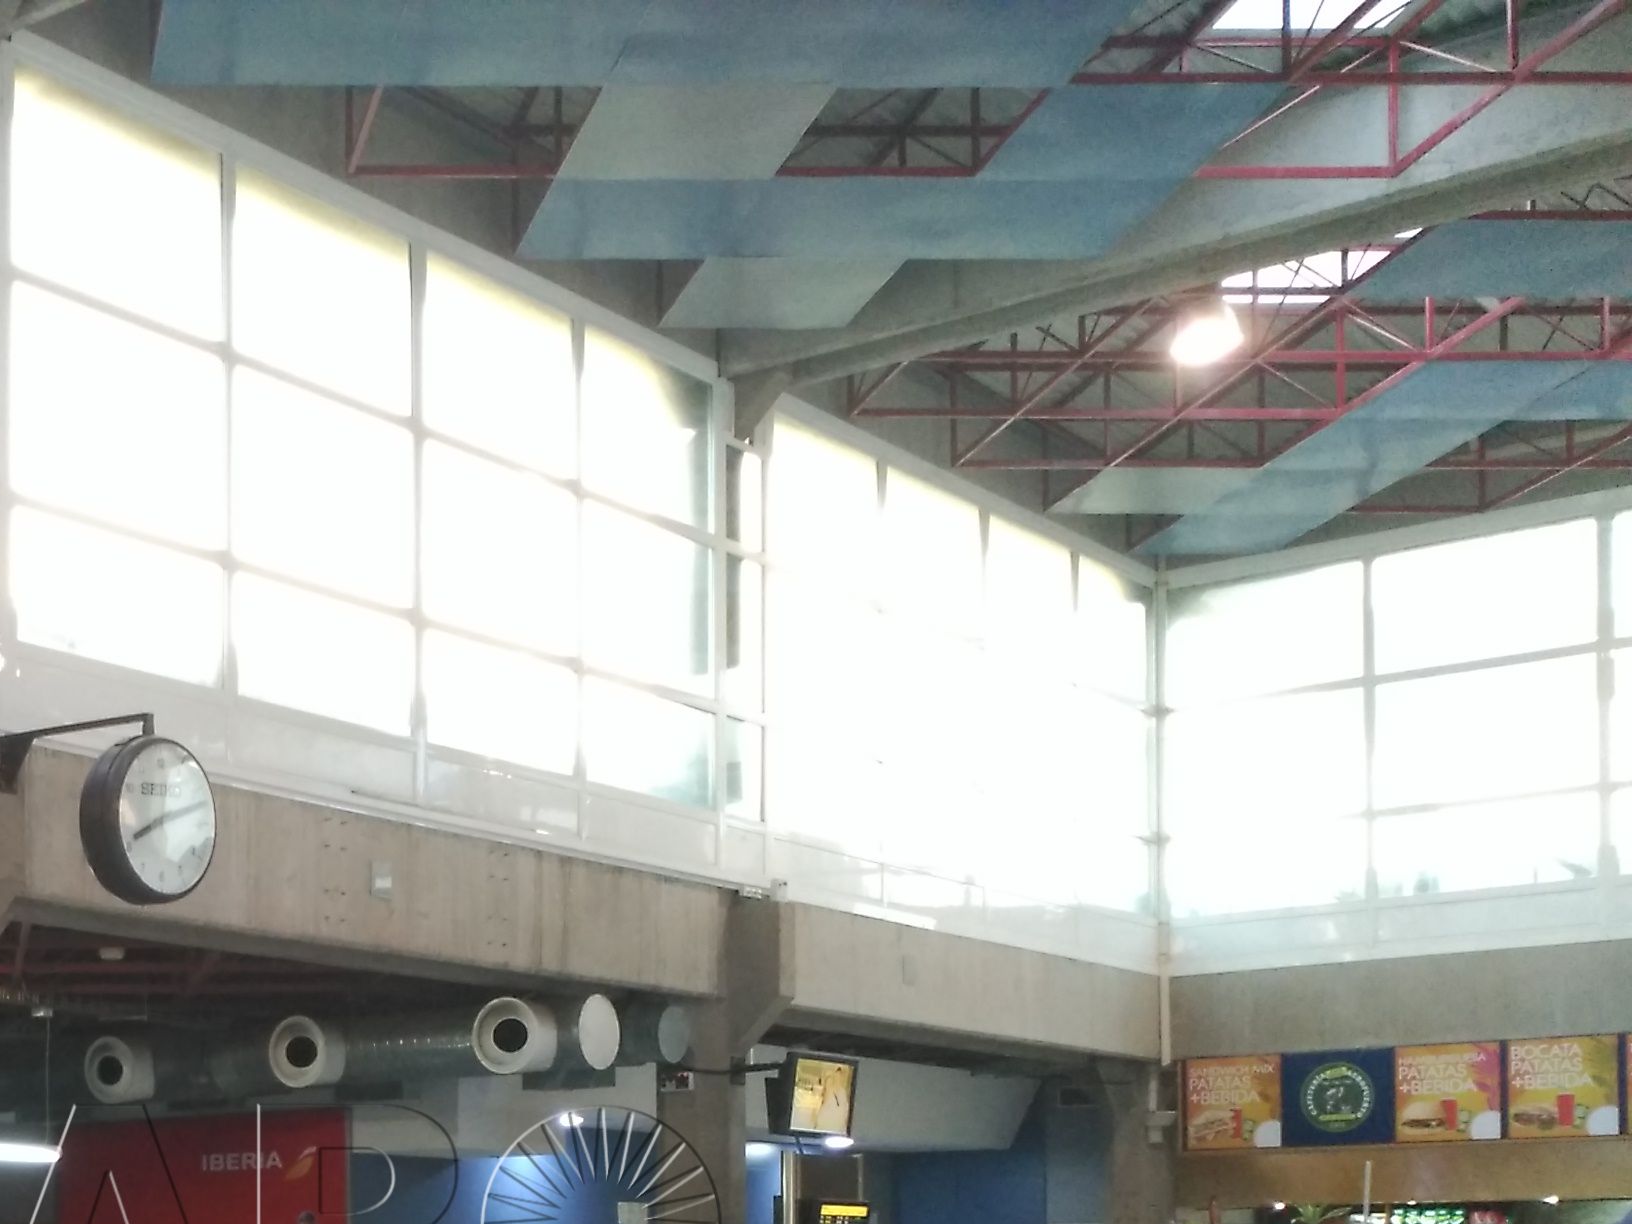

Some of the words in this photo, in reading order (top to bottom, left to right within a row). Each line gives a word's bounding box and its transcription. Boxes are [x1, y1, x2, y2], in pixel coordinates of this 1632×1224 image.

[1512, 1043, 1583, 1060] BOCATA
[1399, 1063, 1468, 1080] PATATAS
[1512, 1056, 1583, 1074] PATATAS
[1190, 1075, 1251, 1091] PATATAS
[202, 1151, 283, 1171] IBERIA
